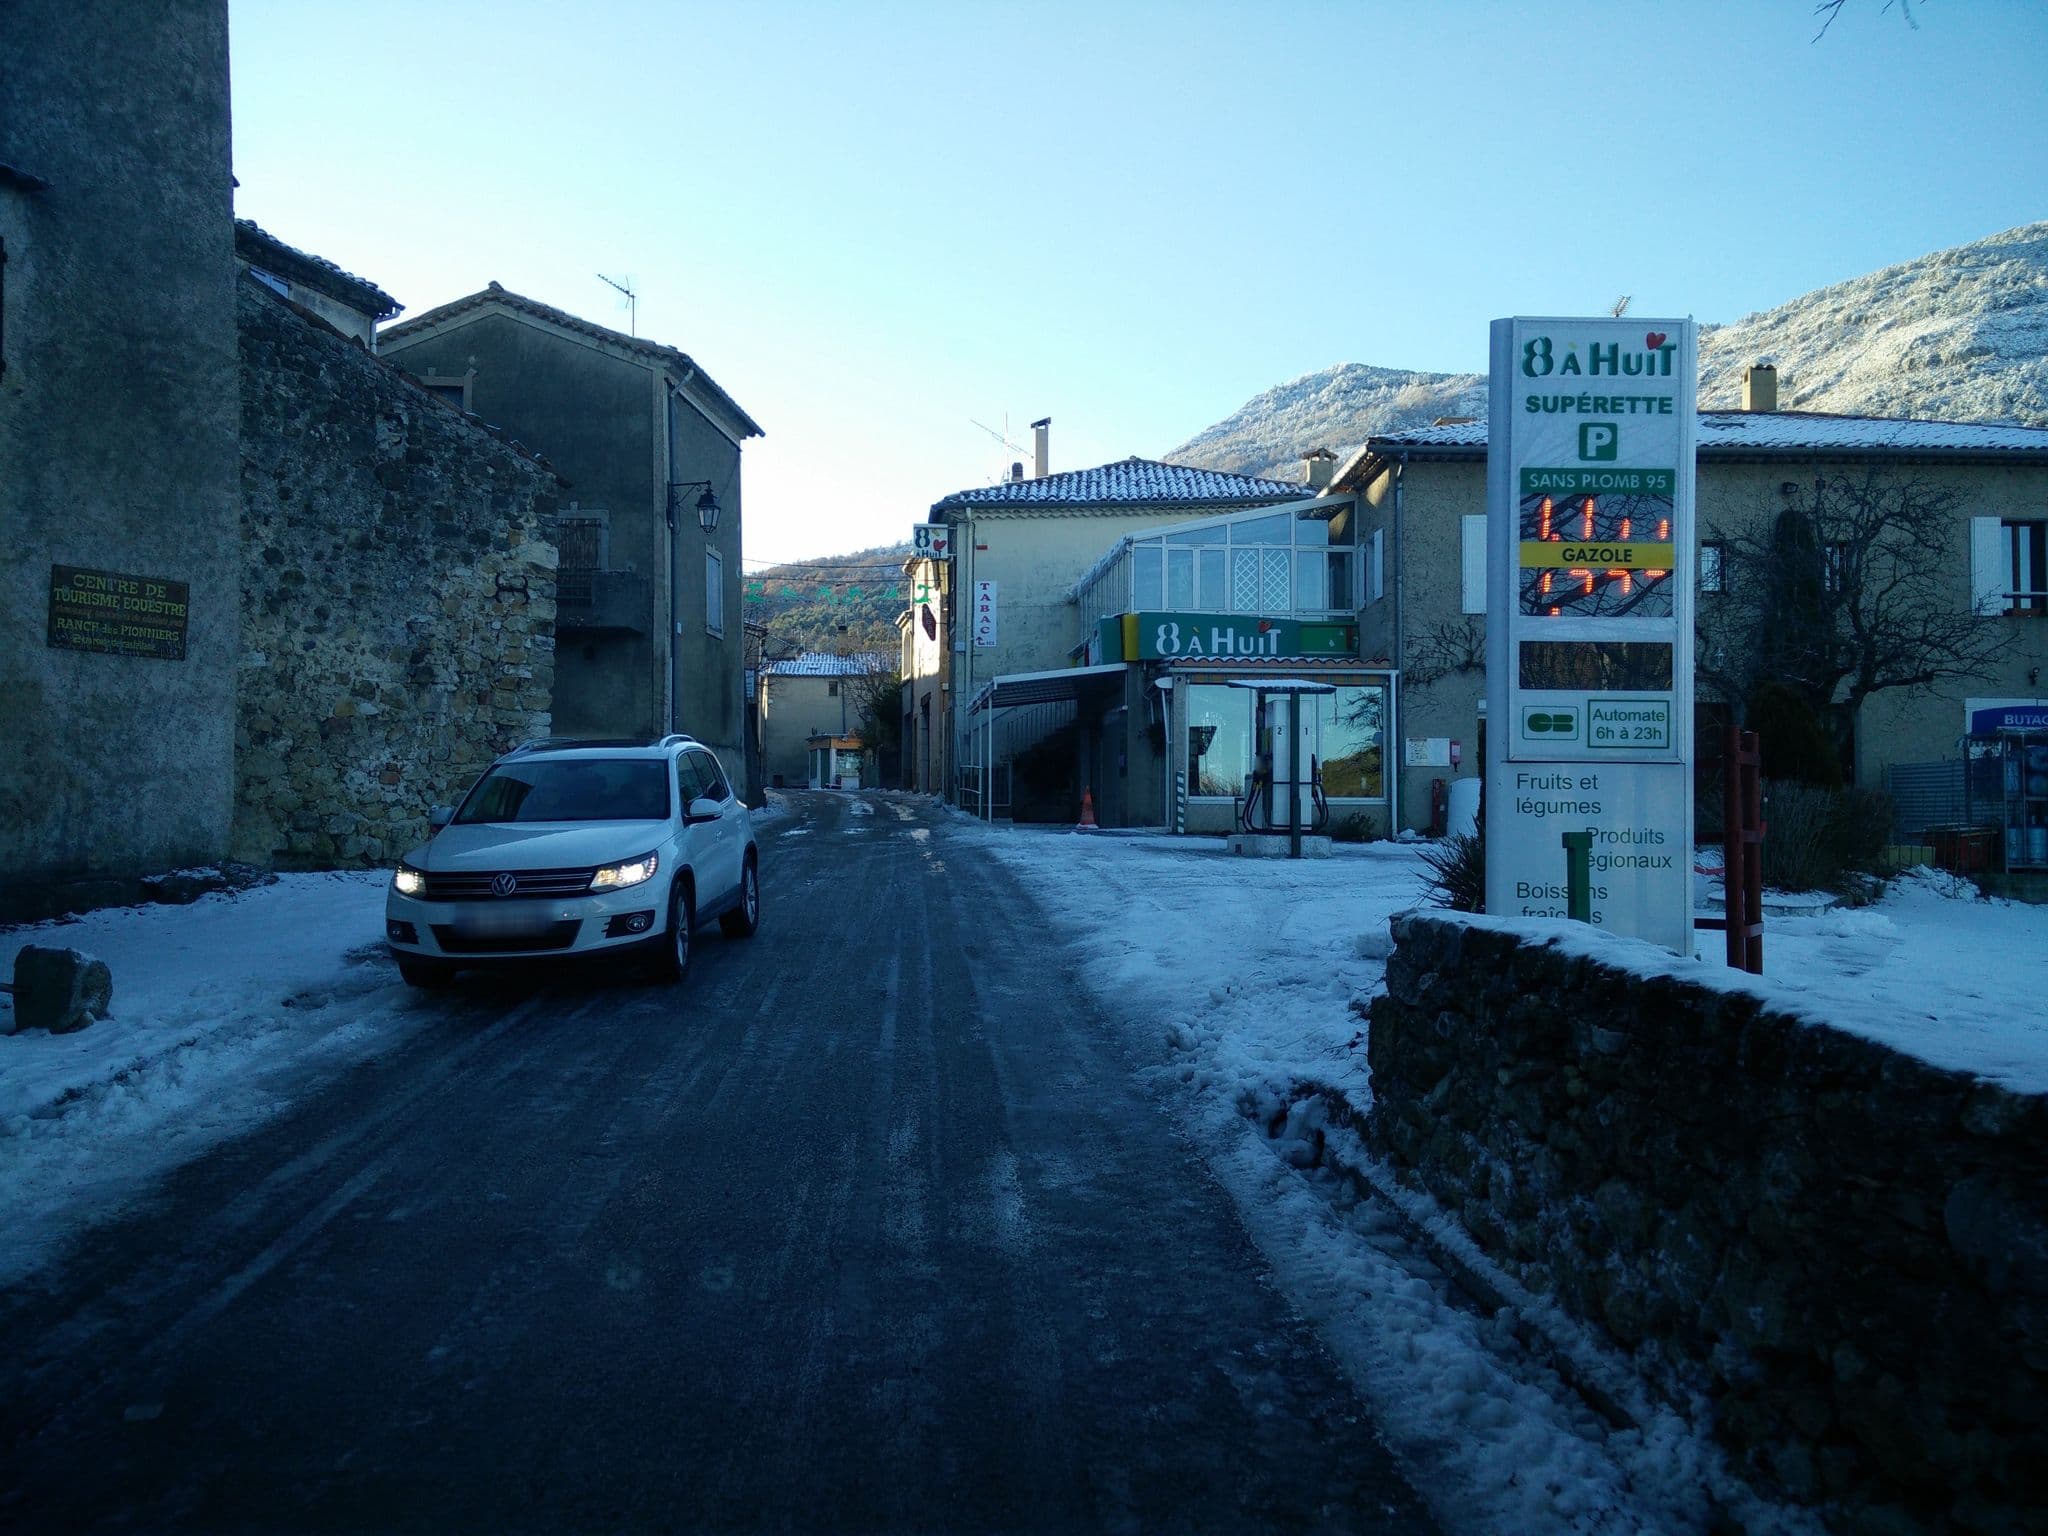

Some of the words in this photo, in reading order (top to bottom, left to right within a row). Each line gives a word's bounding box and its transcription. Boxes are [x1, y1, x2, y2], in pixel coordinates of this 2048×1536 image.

[1522, 336, 1554, 377] 8
[1525, 391, 1673, 414] SUPÉRETTE
[1586, 427, 1613, 457] P
[1529, 473, 1576, 488] SANS
[1582, 474, 1640, 488] PLOMB
[1646, 475, 1666, 489] 95
[915, 528, 930, 548] 8
[1562, 548, 1633, 563] GAZOLE
[73, 574, 138, 595] CENTRE
[145, 583, 167, 599] DE
[54, 587, 120, 608] TOURISME
[123, 597, 186, 617] EQUESTRE
[980, 582, 992, 634] TABAC
[57, 618, 101, 633] RANCH
[121, 624, 180, 641] PIONNIERS
[1156, 622, 1181, 656] 8
[1592, 707, 1666, 723] Automate
[1277, 727, 1282, 735] 2
[1305, 727, 1308, 735] 1
[1596, 726, 1615, 740] 6h
[1619, 726, 1627, 740] à
[1633, 726, 1662, 740] 23h
[1516, 773, 1573, 790] Fruits
[1579, 774, 1599, 790] et
[1516, 796, 1602, 818] légumes
[1586, 827, 1665, 845] Produits
[1588, 851, 1673, 872] égionaux
[1516, 882, 1608, 900] Boissns
